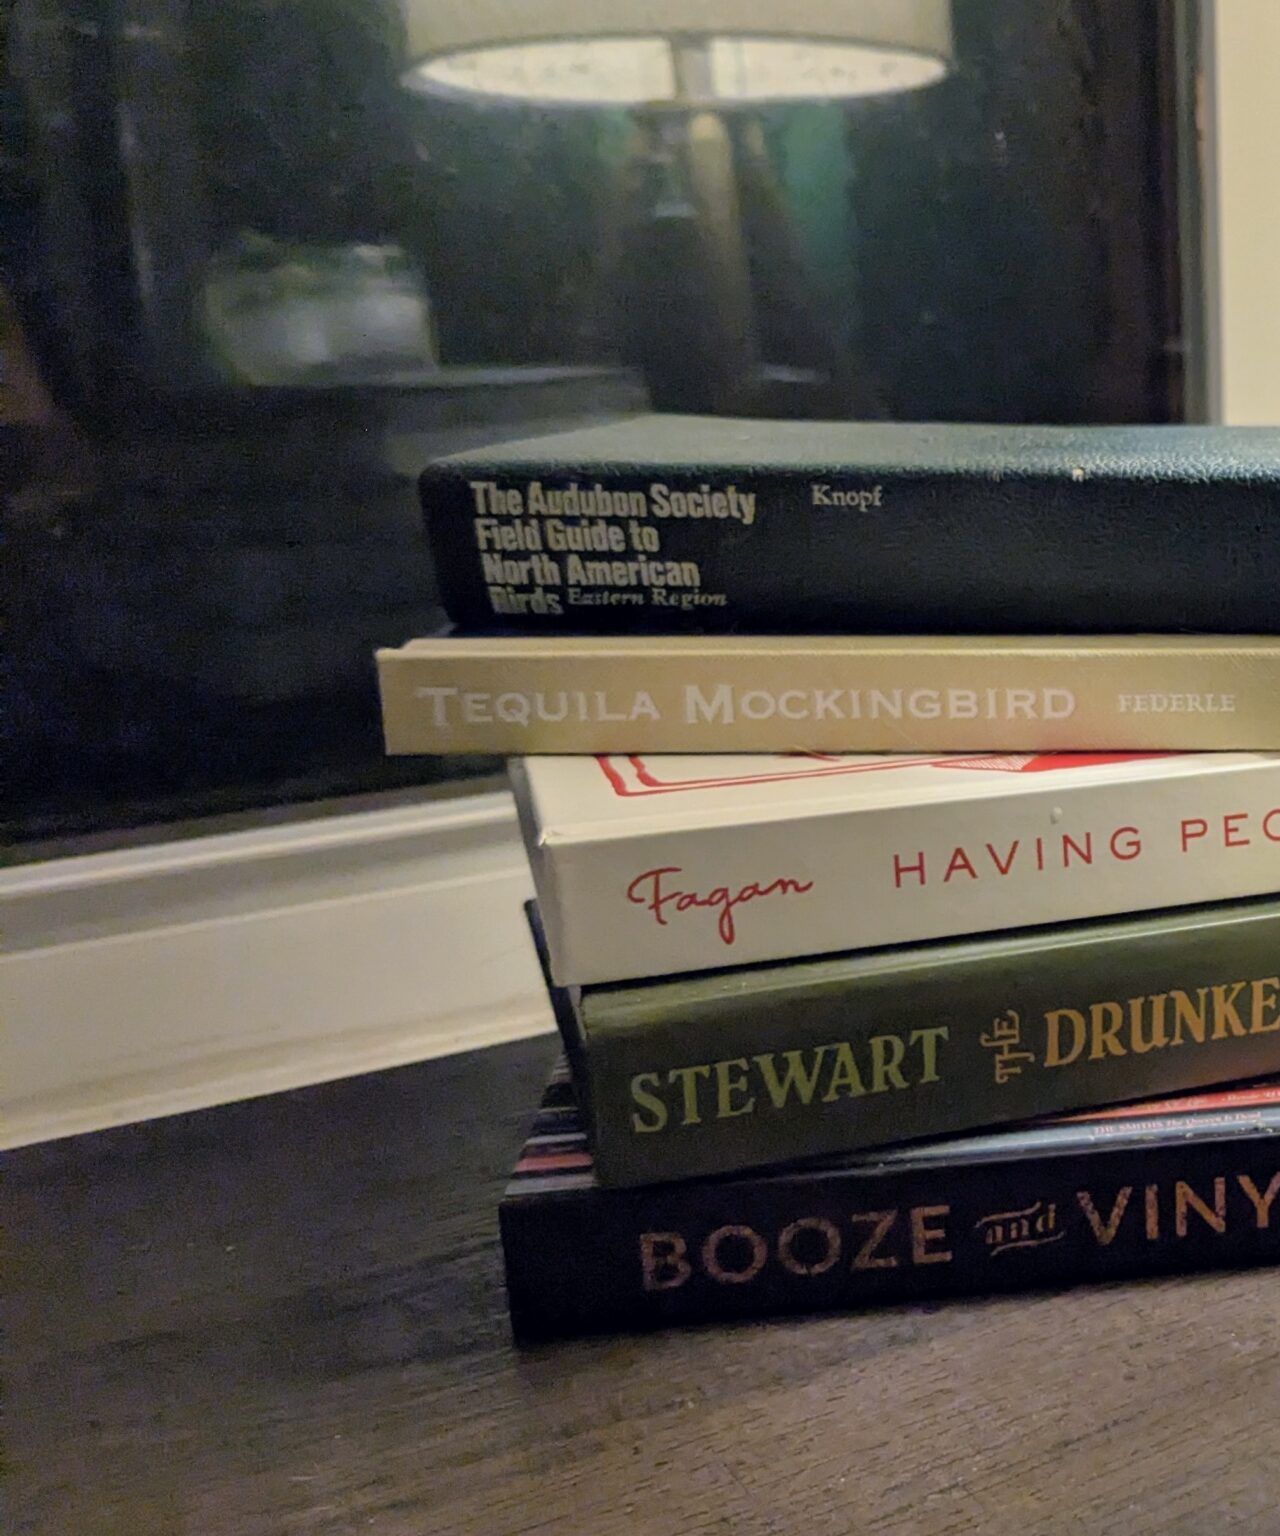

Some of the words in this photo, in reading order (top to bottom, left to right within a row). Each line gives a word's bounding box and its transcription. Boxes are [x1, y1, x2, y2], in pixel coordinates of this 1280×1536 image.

[470, 482, 524, 516] The
[527, 481, 648, 517] Audubon
[651, 483, 756, 525] Society
[810, 484, 883, 512] Knopf
[474, 517, 543, 551] Field
[545, 518, 626, 552] Guide
[629, 520, 660, 552] to
[481, 552, 562, 586] North
[566, 554, 701, 587] American
[488, 586, 564, 614] Birds
[568, 588, 644, 606] Eastern
[651, 588, 728, 611] Region
[418, 686, 661, 726] TEQUILA
[683, 683, 1077, 726] MOCKINGBIRD
[1118, 693, 1236, 714] FEDERLE
[893, 826, 1142, 889] HAVING
[627, 867, 813, 945] Fagan
[629, 1026, 949, 1133] STEWART
[639, 1204, 954, 1292] BOOZE
[984, 1202, 1059, 1248] and
